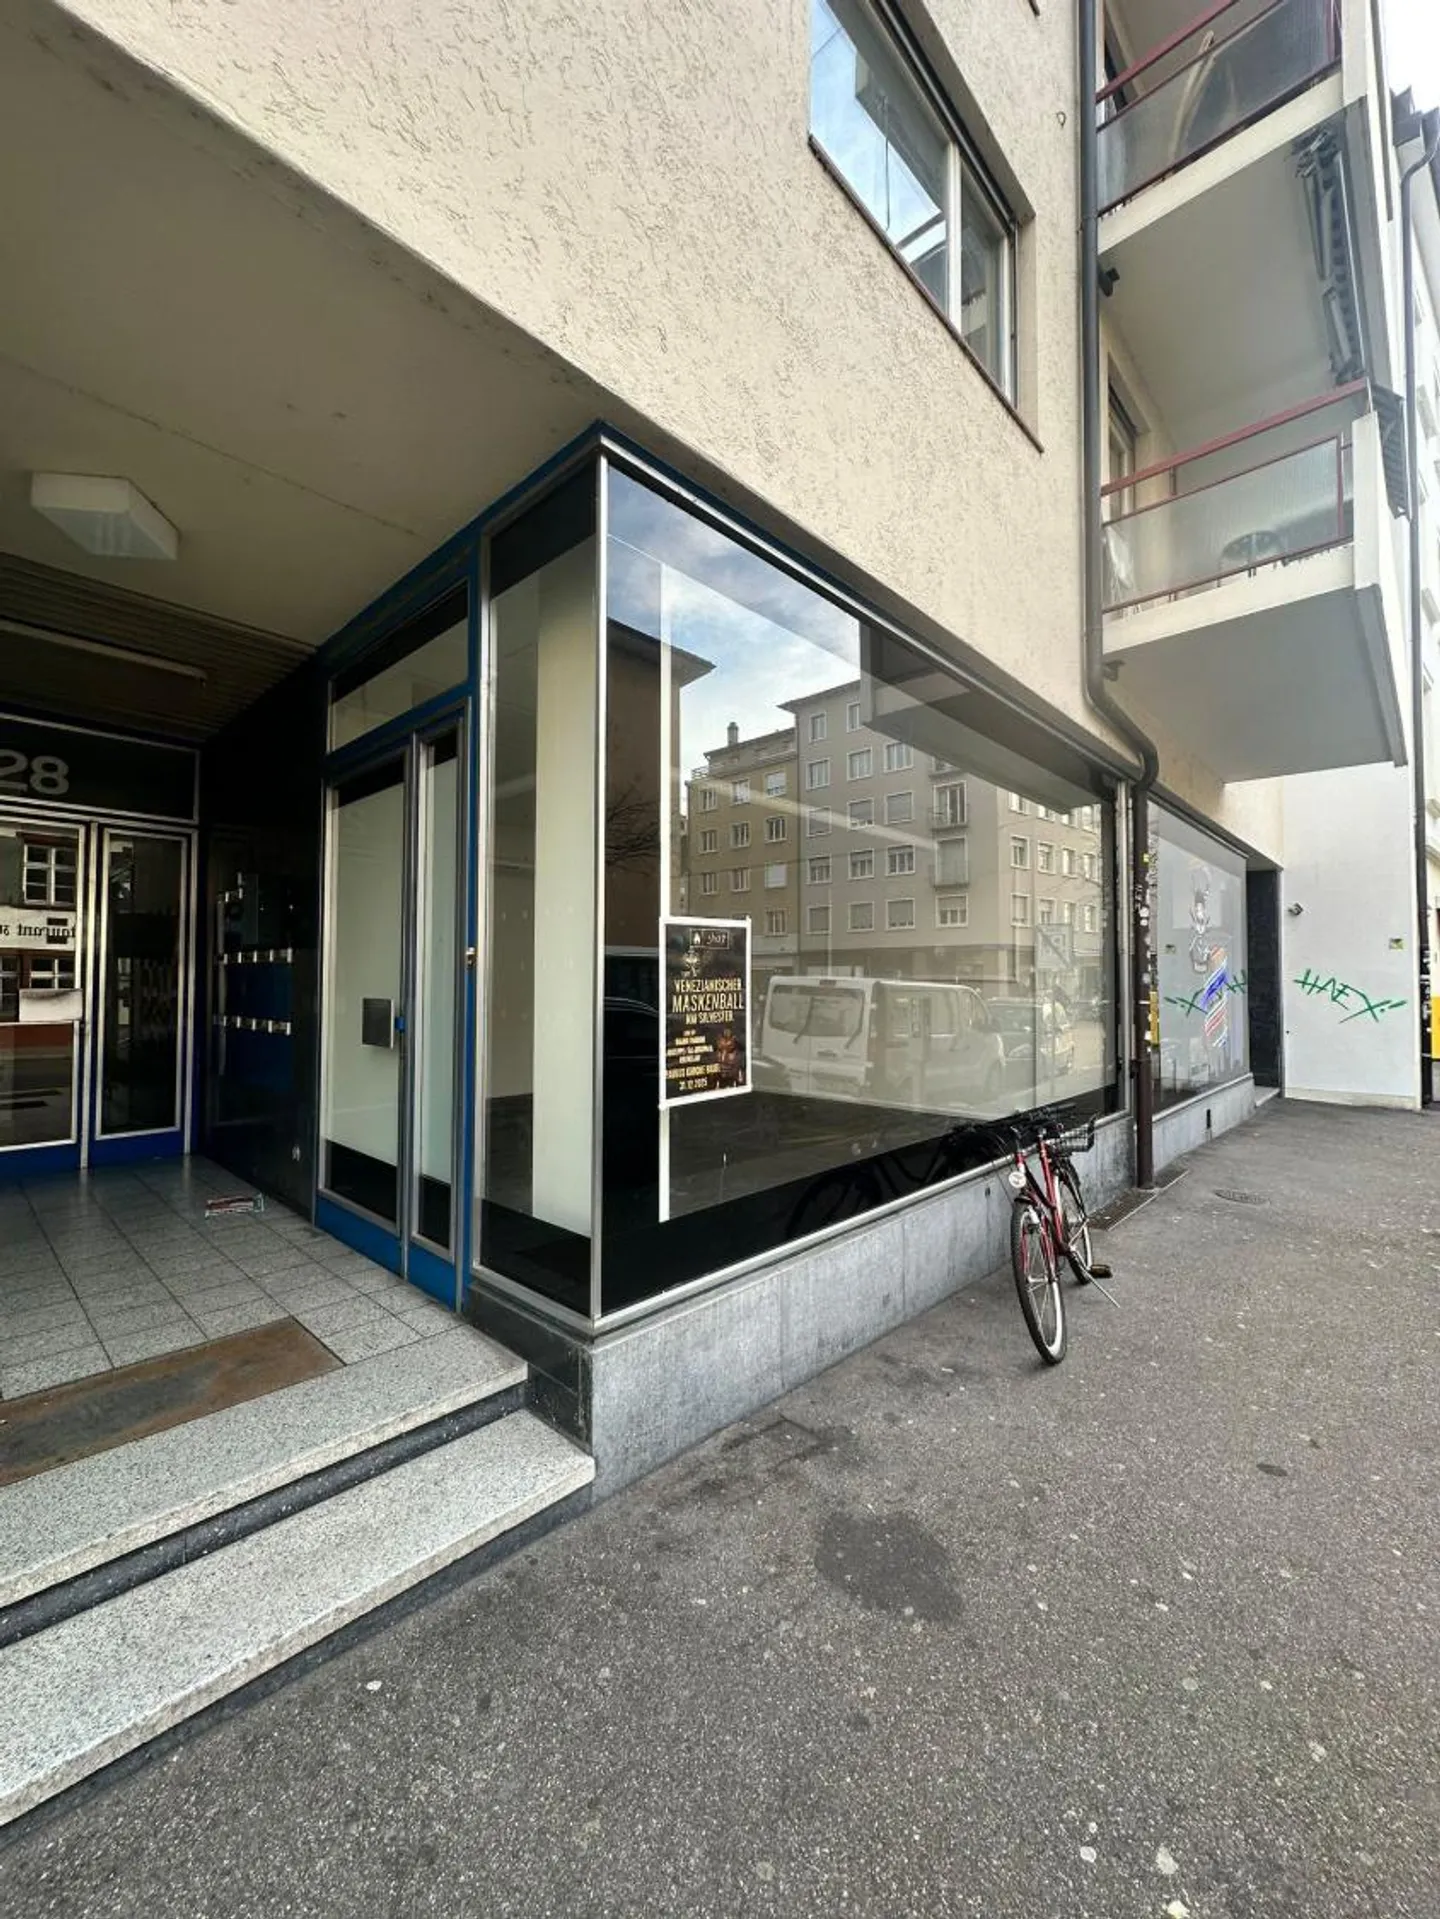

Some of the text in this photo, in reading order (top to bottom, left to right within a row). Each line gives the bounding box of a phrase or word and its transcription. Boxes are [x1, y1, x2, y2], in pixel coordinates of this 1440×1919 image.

[0, 749, 69, 795] 28
[674, 977, 742, 993] VENEZIANISCHER
[672, 992, 744, 1013] MASKENBALL
[699, 1010, 734, 1024] SILVESTER
